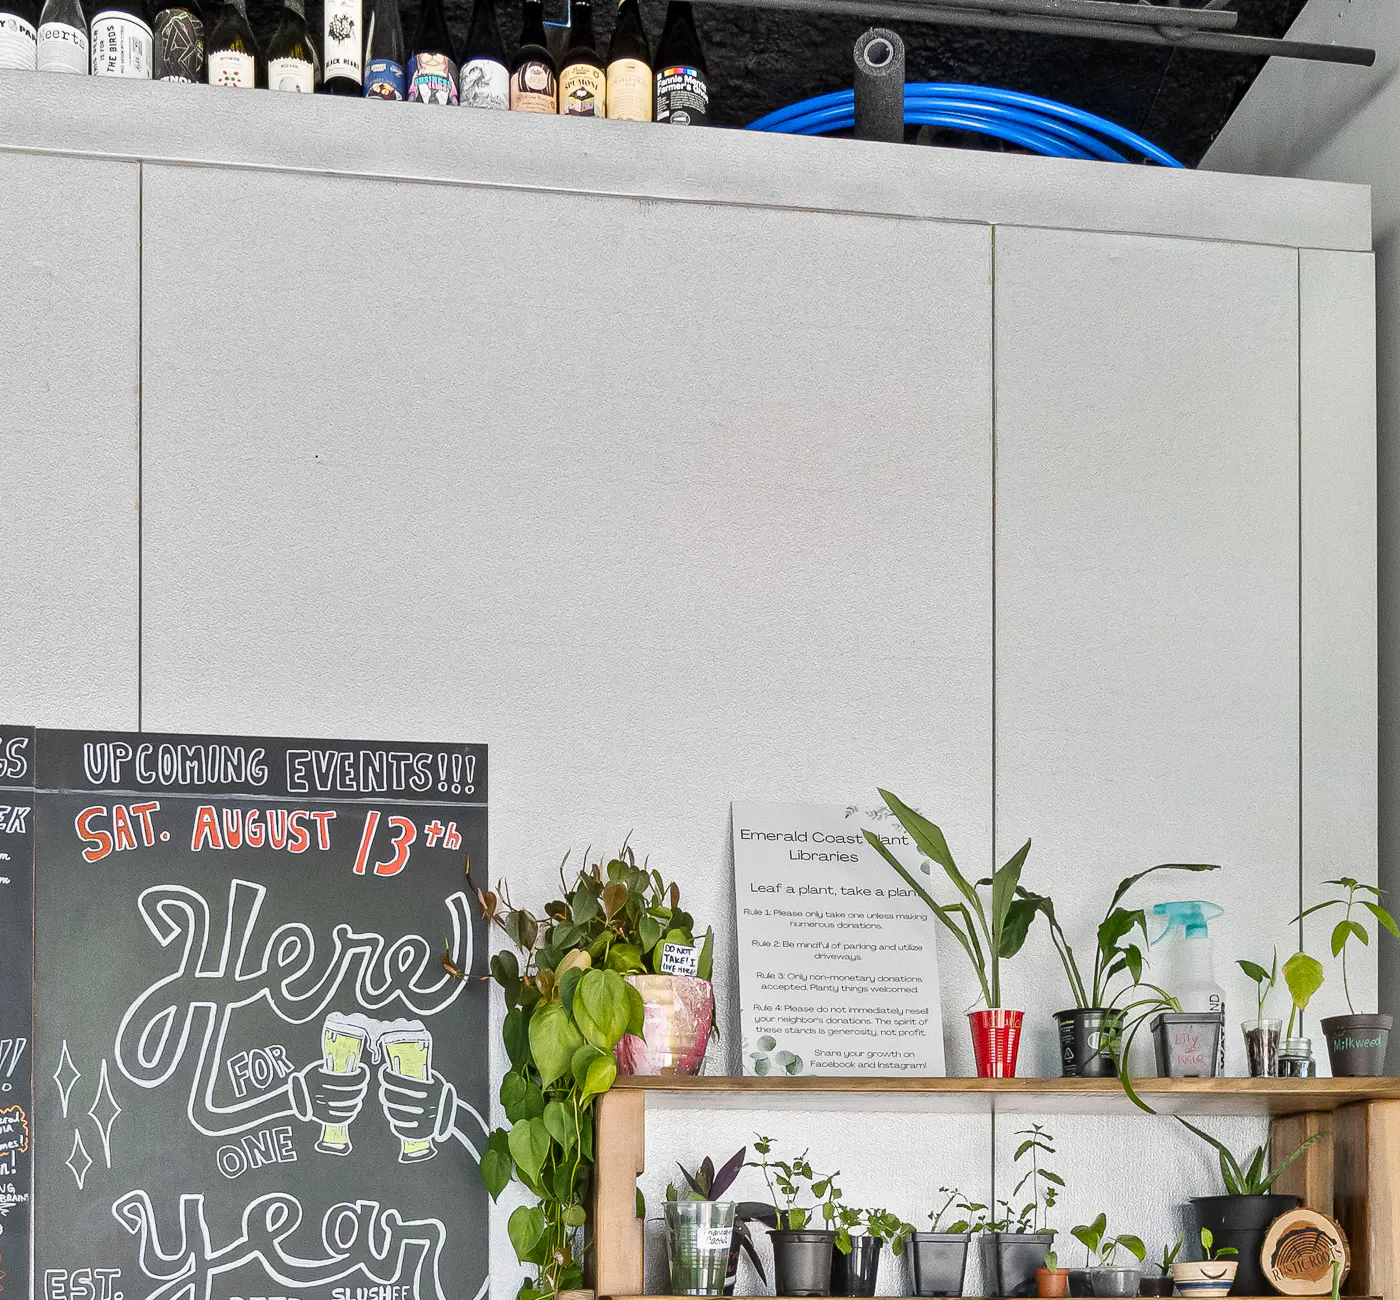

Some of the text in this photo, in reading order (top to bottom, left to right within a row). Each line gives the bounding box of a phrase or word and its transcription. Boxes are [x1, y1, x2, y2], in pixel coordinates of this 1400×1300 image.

[106, 25, 118, 73] THE BIRDS
[83, 742, 477, 795] UPCOMING EVENTS!!!
[75, 801, 171, 863] SAT.
[190, 805, 337, 854] AUGUST
[740, 828, 910, 847] Emerald Coast lant
[789, 849, 860, 864] Libraries
[750, 882, 783, 894] Leaf
[785, 885, 796, 895] a
[798, 884, 838, 898] plant,
[839, 885, 871, 897] take
[875, 888, 885, 898] a
[743, 908, 763, 916] Rule
[773, 909, 804, 918] Please
[804, 911, 824, 920] only
[825, 911, 846, 919] take
[847, 912, 865, 920] one
[866, 912, 895, 921] unless
[895, 913, 928, 922] making
[789, 921, 883, 930] numerous donations.
[751, 940, 772, 948] Rule
[782, 940, 795, 948] Be
[796, 941, 830, 949] mindful
[831, 941, 842, 950] of
[843, 943, 877, 952] parking
[878, 943, 897, 951] and
[897, 943, 923, 952] utilize
[813, 952, 863, 962] driveways.
[756, 971, 776, 980] Rule
[787, 972, 808, 982] Only
[809, 973, 876, 983] non-monetary
[877, 975, 923, 983] donations
[809, 984, 839, 994] Planty
[841, 984, 869, 994] things
[870, 985, 919, 994] welcomed.
[753, 1003, 773, 1012] Rule
[784, 1004, 815, 1013] Please
[816, 1005, 829, 1014] do
[830, 1006, 847, 1014] not
[848, 1006, 904, 1017] immediately
[905, 1007, 930, 1015] resell
[754, 1015, 930, 1028] your neighbor's donations. The spirit of
[755, 1025, 783, 1034] these
[784, 1026, 817, 1035] stands
[818, 1026, 826, 1034] is
[880, 1028, 897, 1036] not
[898, 1028, 928, 1038] profit.
[1333, 1033, 1383, 1053] Milkweed
[814, 1048, 916, 1059] Share your growth on
[226, 1044, 295, 1098] FOR
[810, 1060, 928, 1071] Facebook and Instagram!
[216, 1126, 299, 1179] ONE
[1272, 1259, 1309, 1281] RUSTIC
